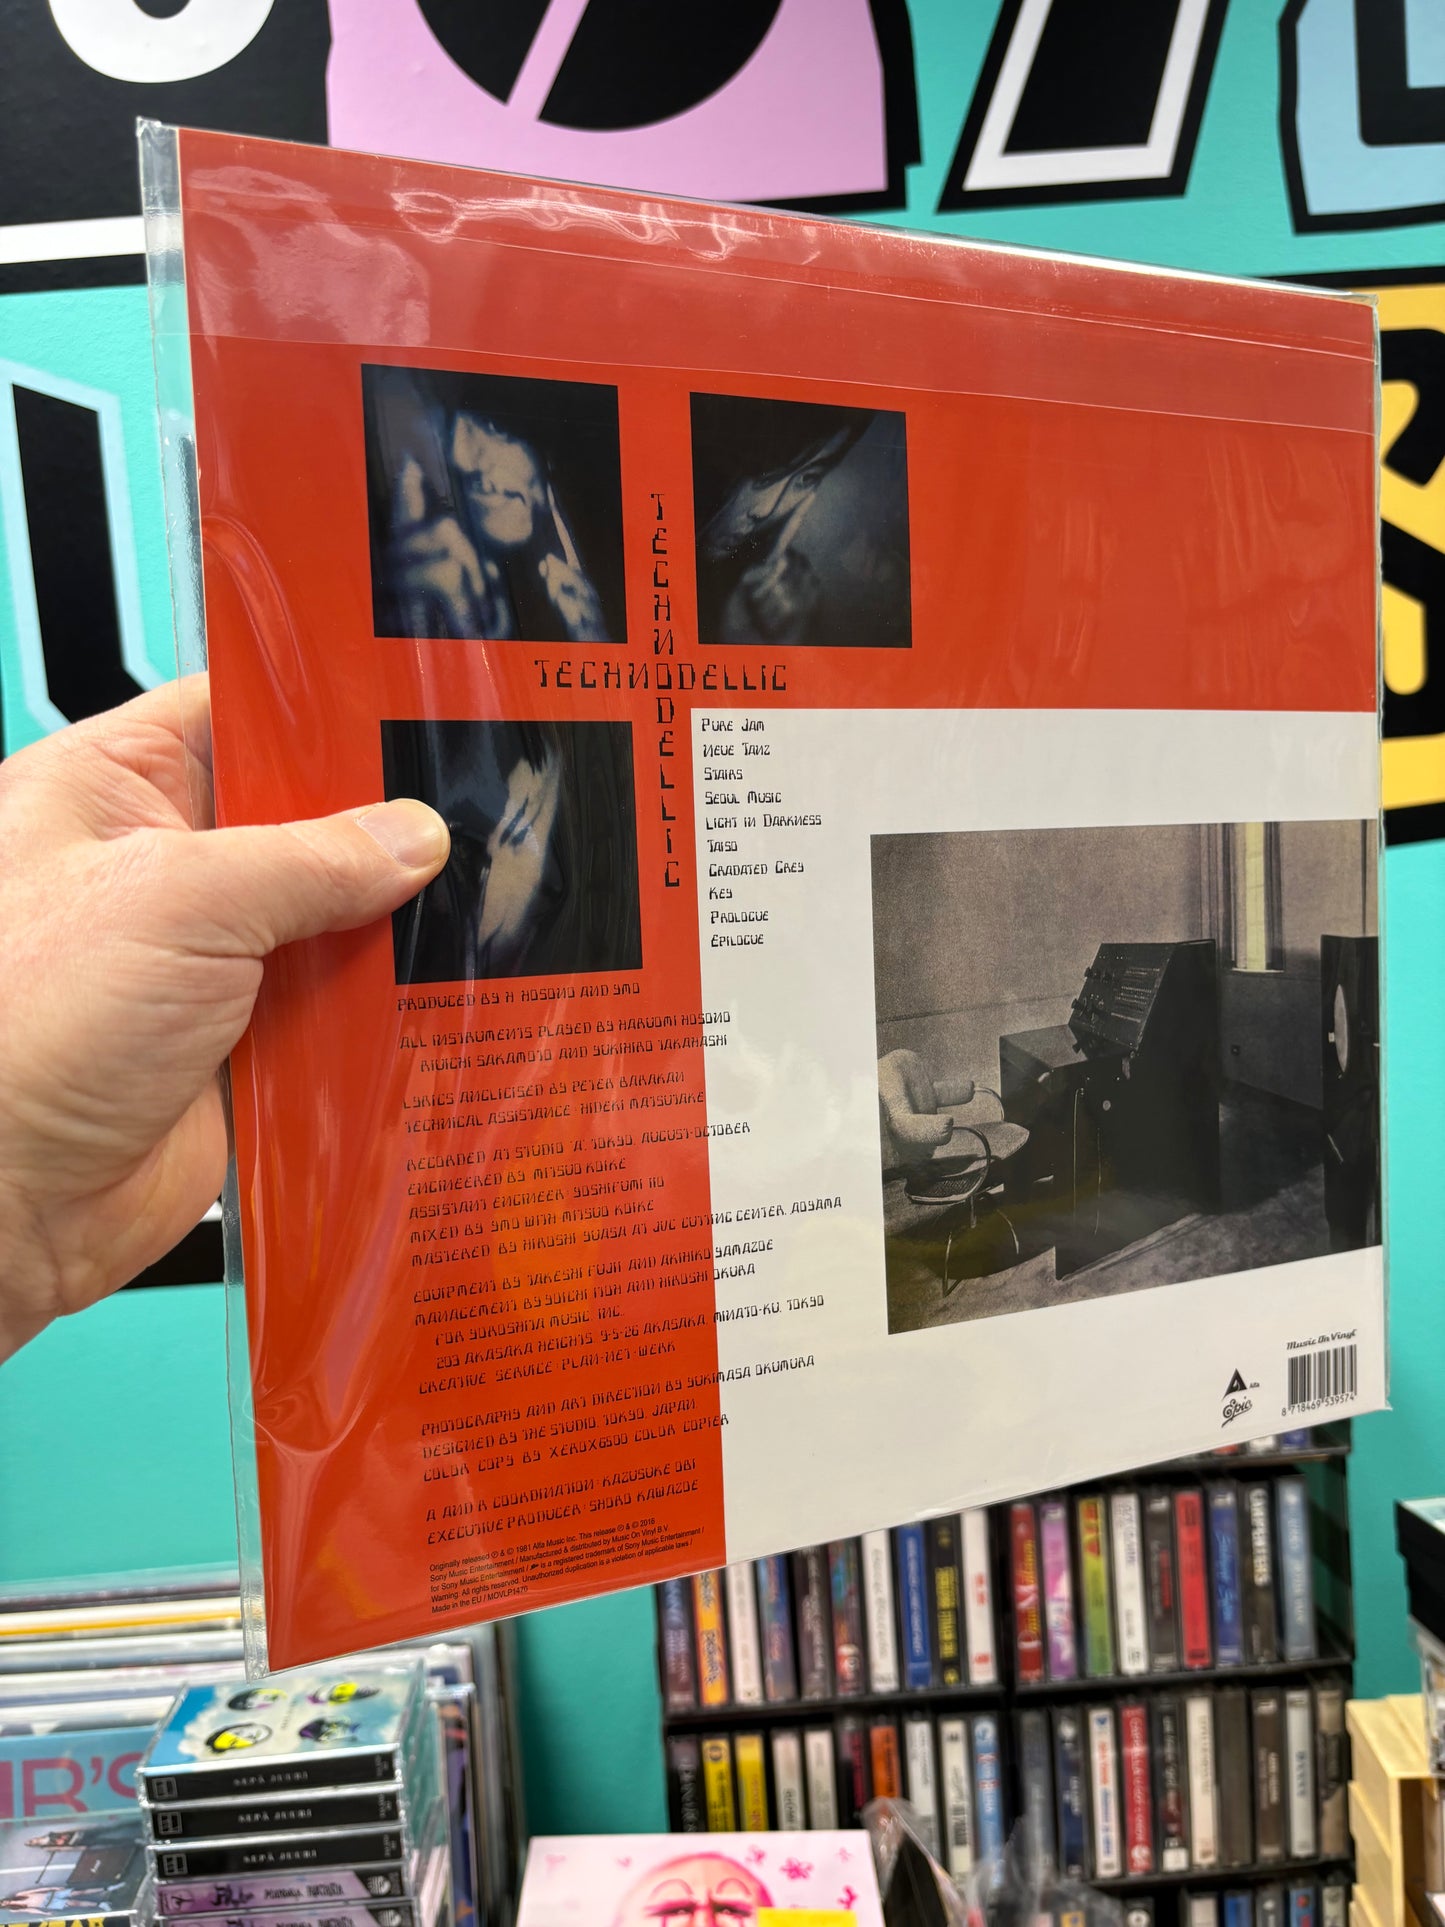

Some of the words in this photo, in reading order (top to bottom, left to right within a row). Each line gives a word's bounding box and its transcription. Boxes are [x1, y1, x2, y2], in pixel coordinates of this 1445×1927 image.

[534, 660, 786, 691] TECHNODELLIC
[650, 493, 680, 887] TECHNODELLIC
[398, 993, 475, 1011] PRODUCED
[481, 992, 499, 1005] BY
[506, 992, 514, 1003] H
[521, 987, 575, 1001] HOSONO
[580, 985, 608, 998] AND
[613, 983, 640, 995] YMO
[400, 1036, 427, 1049] ALL
[432, 1026, 532, 1046] INSTRUMENTS
[538, 1021, 592, 1037] PLAYED
[596, 1020, 614, 1033] BY
[618, 1015, 677, 1031] HARUOMI
[682, 1011, 731, 1026] HOSONO
[421, 1057, 471, 1072] RIUICHI
[477, 1049, 552, 1067] SAKAMOTO
[559, 1045, 588, 1060] AND
[593, 1040, 653, 1057] YUKIHIRO
[658, 1034, 728, 1050] TAKAHASHI
[403, 1093, 454, 1109] LYRICS
[460, 1084, 543, 1104] ANGLICISED
[549, 1083, 567, 1095] BY
[573, 1077, 614, 1092] PETER
[620, 1071, 685, 1088] BARAKAN
[405, 1114, 483, 1133] TECHNICAL
[580, 1099, 624, 1115] HIDEKI
[630, 1092, 704, 1110] MATSUTAKE
[406, 1151, 485, 1171] RECORDED
[493, 1148, 510, 1161] AT
[516, 1142, 564, 1159] STUDIO
[407, 1173, 502, 1196] ENGINEERED
[507, 1171, 525, 1183] BY
[533, 1163, 581, 1180] MITSUO
[586, 1158, 626, 1174] KOIKE
[409, 1199, 487, 1220] ASSISTANT
[573, 1178, 643, 1199] YOSHIFUMI
[410, 1226, 458, 1243] MIXED
[464, 1222, 483, 1236] BY
[491, 1217, 520, 1233] YMO
[525, 1212, 557, 1228] WITH
[562, 1205, 609, 1223] MITSUO
[615, 1199, 654, 1215] KOIKE
[412, 1244, 490, 1267] MASTERED
[498, 1240, 517, 1254] BY
[523, 1232, 576, 1251] HIROSHI
[583, 1226, 627, 1243] YUASA
[632, 1222, 647, 1238] AT
[653, 1217, 676, 1233] JVC
[681, 1211, 732, 1229] CUTTING
[791, 1197, 842, 1215] AOYAMA
[413, 1280, 497, 1304] EQUIPMENT
[502, 1276, 521, 1290] BY
[527, 1267, 583, 1286] TAKESHI
[588, 1260, 621, 1278] FUJII
[628, 1256, 656, 1272] AND
[661, 1248, 711, 1266] AKIHIKO
[715, 1239, 774, 1259] YAMAZOE
[415, 1299, 518, 1326] MANAGEMENT
[523, 1296, 541, 1310] BY
[545, 1288, 588, 1306] YUICHI
[627, 1278, 655, 1294] AND
[659, 1270, 708, 1288] HIROSHI
[713, 1263, 756, 1281] OKURA
[435, 1331, 464, 1346] FOR
[469, 1317, 545, 1341] YOROSHITA
[436, 1355, 460, 1370] 203
[464, 1342, 533, 1365] AKASAKA
[786, 1295, 825, 1311] TOKYO
[1286, 1337, 1316, 1350] Music
[1331, 1329, 1357, 1341] Vinyl
[419, 1372, 487, 1395] CREATIVE
[421, 1408, 521, 1436] PHOTOGRAPHY
[526, 1401, 556, 1418] AND
[560, 1397, 587, 1412] ART
[592, 1382, 661, 1406] DIRECTION
[665, 1379, 683, 1393] BY
[687, 1366, 751, 1389] YUKIMASA
[755, 1354, 815, 1376] OKUMURA
[1221, 1395, 1252, 1426] Epic
[423, 1435, 494, 1459] DESIGNED
[498, 1431, 518, 1446] BY
[522, 1425, 546, 1441] THE
[423, 1463, 470, 1482] COLOR
[478, 1454, 514, 1472] COPY
[522, 1450, 541, 1464] BY
[634, 1424, 676, 1442] COLOR
[683, 1413, 729, 1433] COPIER
[426, 1508, 436, 1522] A
[442, 1503, 473, 1519] AND
[478, 1500, 488, 1512] R
[602, 1463, 671, 1488] KAZUSUKE
[675, 1457, 696, 1472] OBI
[427, 1519, 504, 1545] EXECUTIVE
[589, 1493, 632, 1512] SHORO
[636, 1479, 699, 1502] KAWAZOE
[516, 1544, 531, 1553] 1981
[1249, 1488, 1271, 1586] CARPENTERS
[471, 1596, 481, 1605] EU
